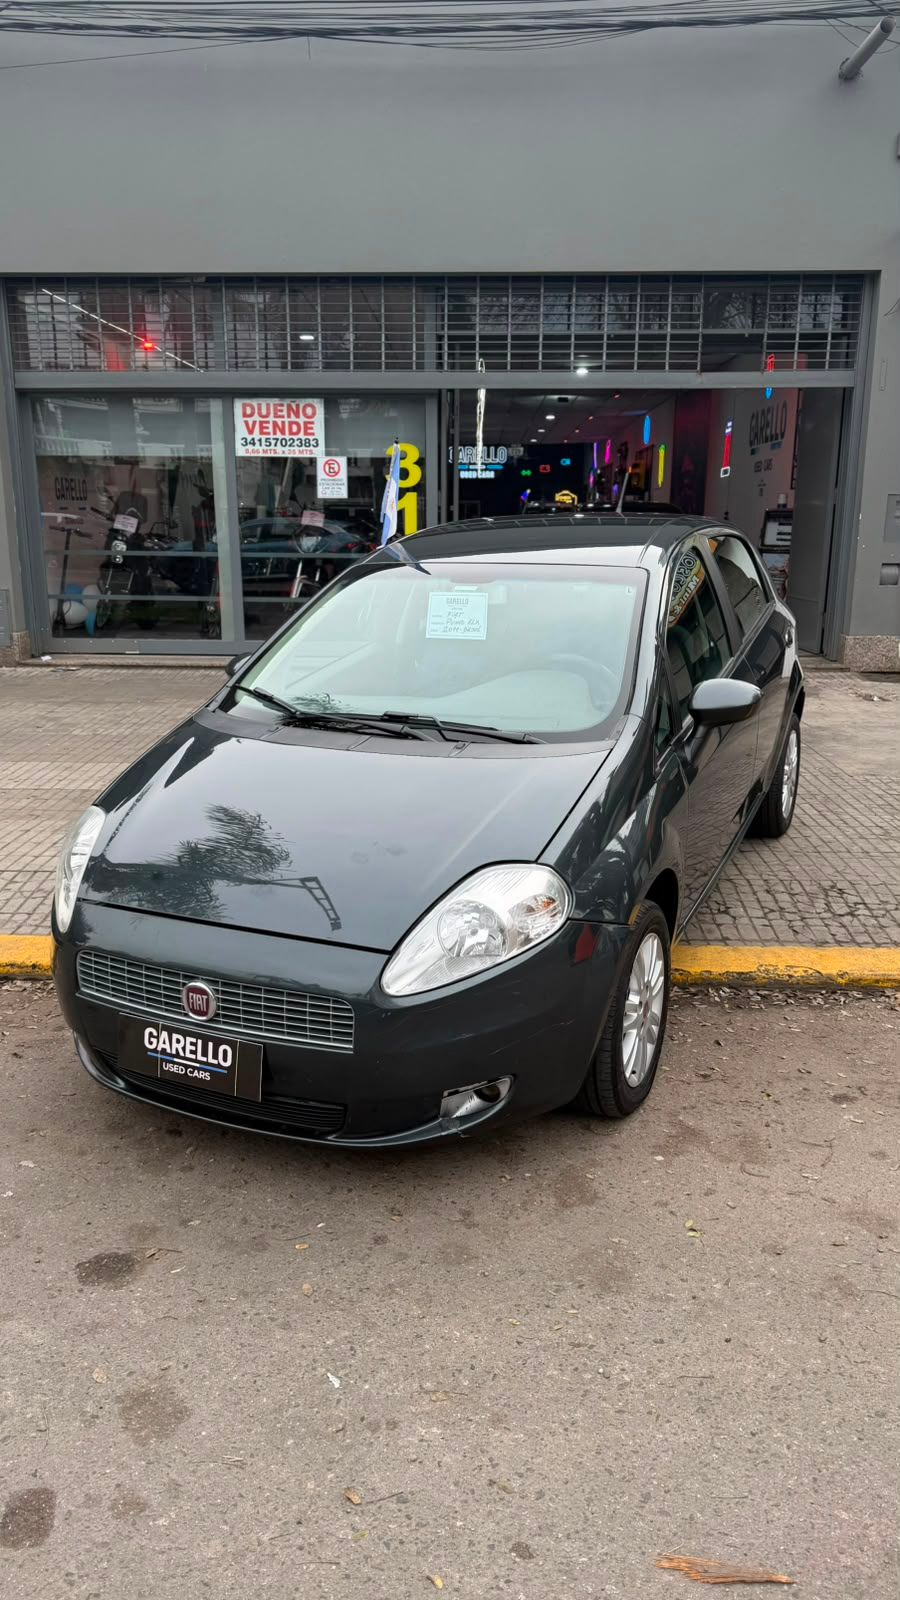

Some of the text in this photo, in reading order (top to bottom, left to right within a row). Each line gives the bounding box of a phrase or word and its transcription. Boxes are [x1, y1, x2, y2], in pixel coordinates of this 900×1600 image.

[242, 399, 316, 419] DUEÑO
[243, 420, 315, 436] VENDE
[749, 400, 787, 447] GARELLO
[240, 437, 319, 448] 3415702383
[448, 446, 508, 463] ARLLO
[55, 477, 88, 501] GARELLO
[188, 992, 208, 1012] FIAT
[144, 1027, 233, 1067] GARELLO
[162, 1062, 211, 1081] USED CARS
